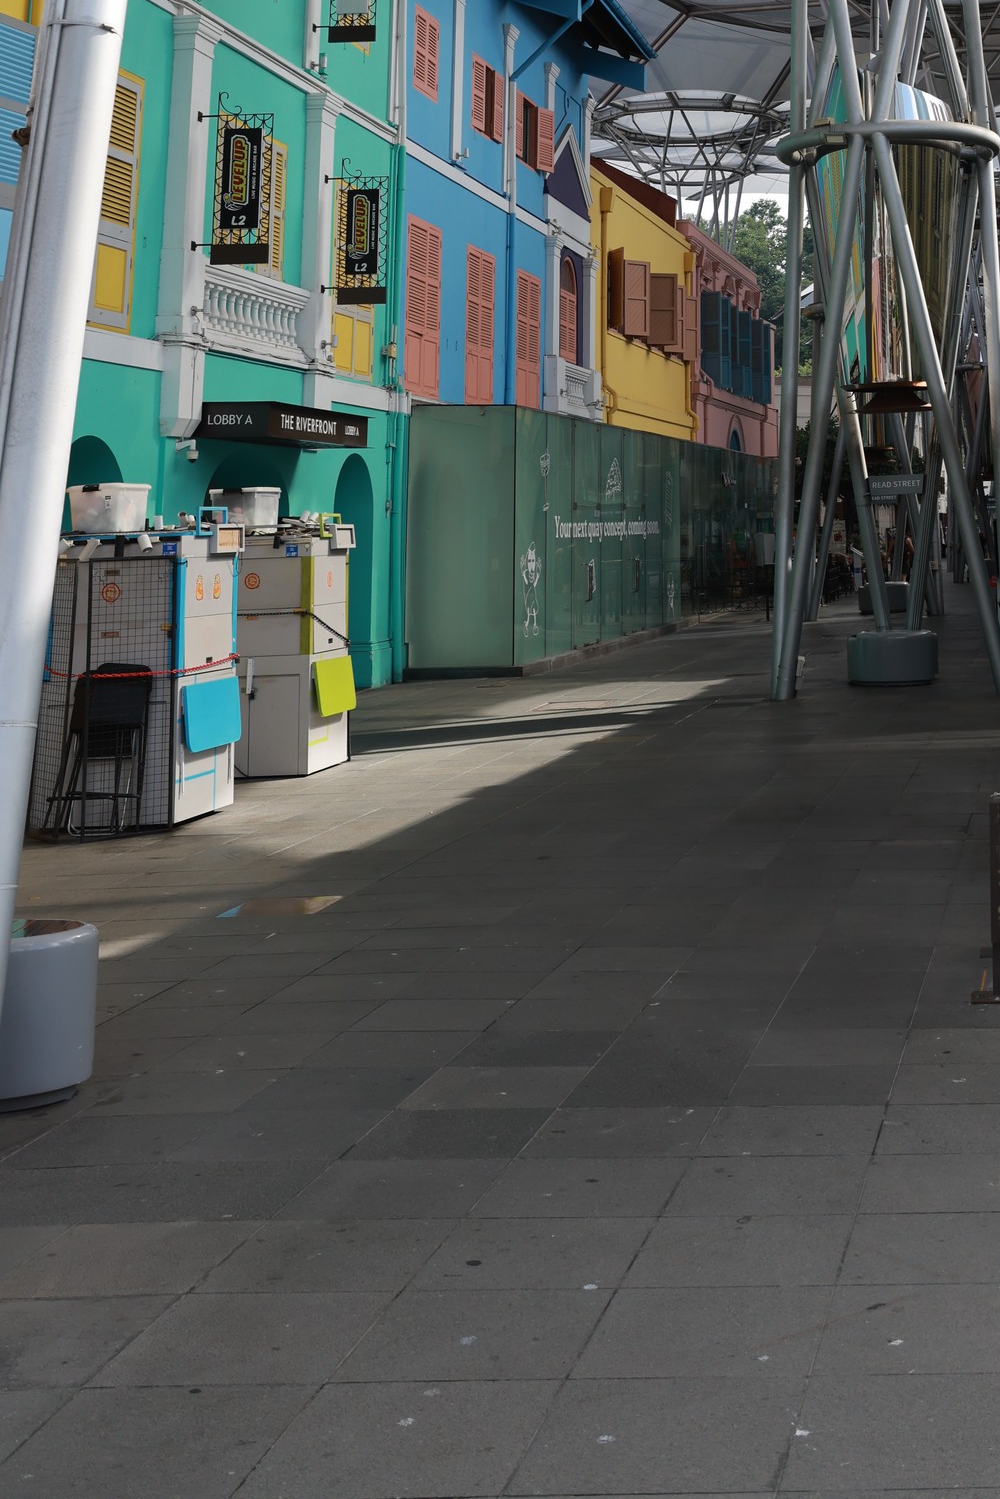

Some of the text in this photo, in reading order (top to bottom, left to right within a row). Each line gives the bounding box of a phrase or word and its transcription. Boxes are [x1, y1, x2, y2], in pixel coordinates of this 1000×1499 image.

[231, 215, 246, 226] L2
[354, 263, 367, 272] L2
[207, 414, 253, 426] LOBBY A
[281, 413, 337, 436] THE RIVERFRONT
[344, 425, 360, 437] LOBBY A
[893, 480, 920, 488] STREET
[554, 515, 572, 538] Your
[572, 520, 587, 538] next
[587, 521, 604, 543] quay
[603, 519, 628, 541] concept,
[627, 515, 647, 539] coming
